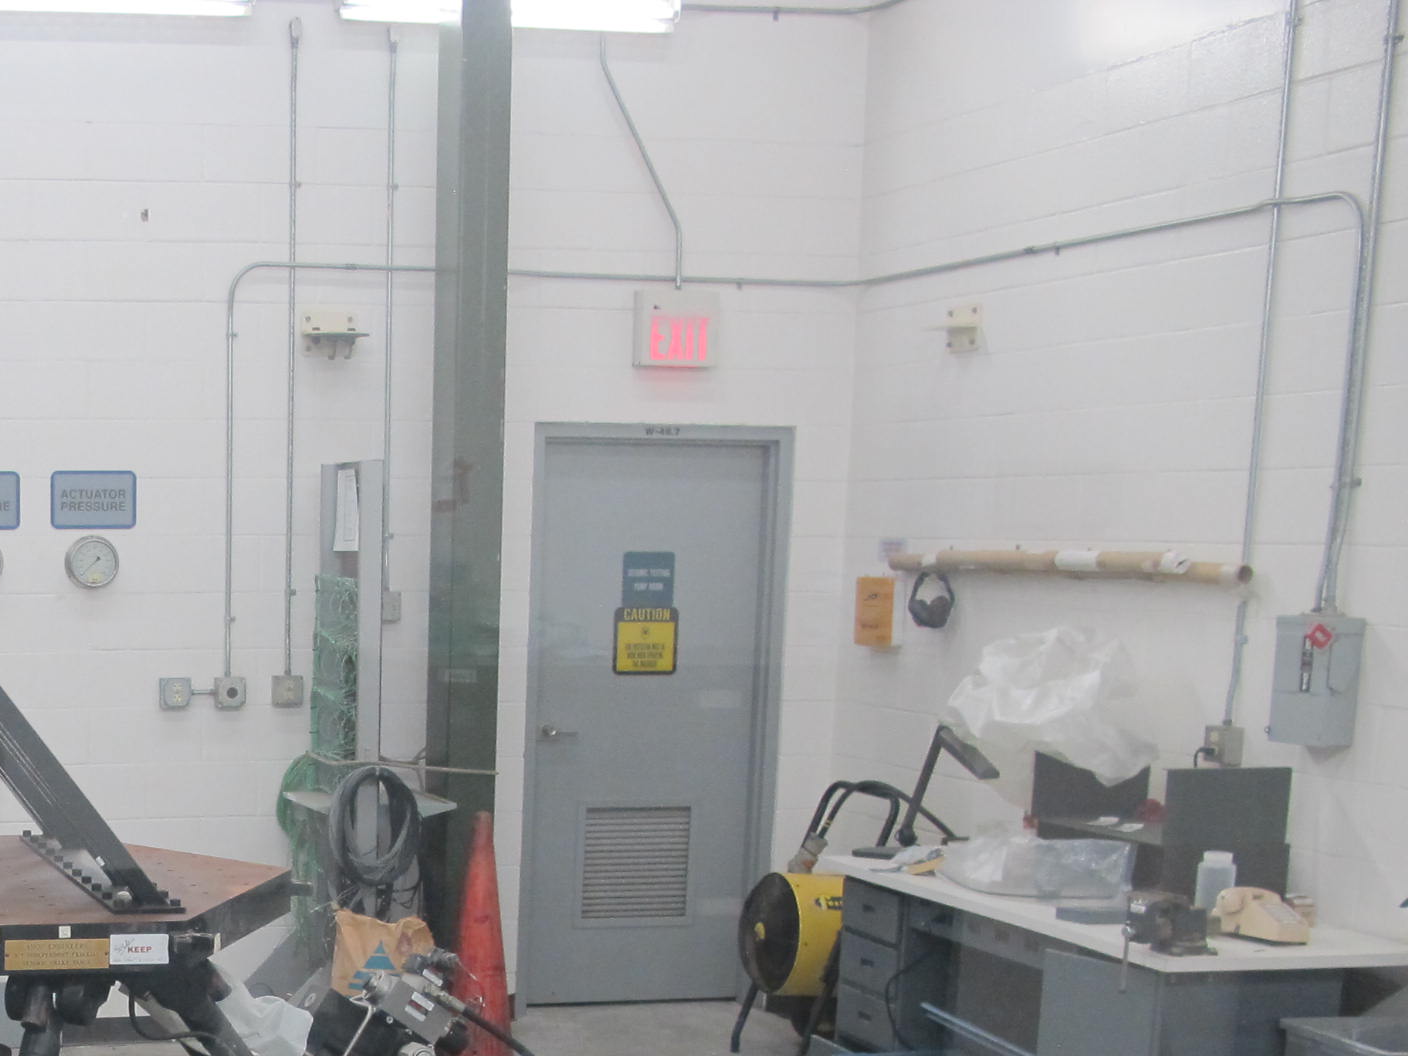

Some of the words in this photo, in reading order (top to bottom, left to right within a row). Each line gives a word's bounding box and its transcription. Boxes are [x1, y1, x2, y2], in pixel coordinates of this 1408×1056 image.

[649, 316, 710, 361] EXIT
[60, 488, 127, 499] ACTUATOR
[60, 501, 127, 512] PRESSURE
[623, 607, 671, 621] CAUTION
